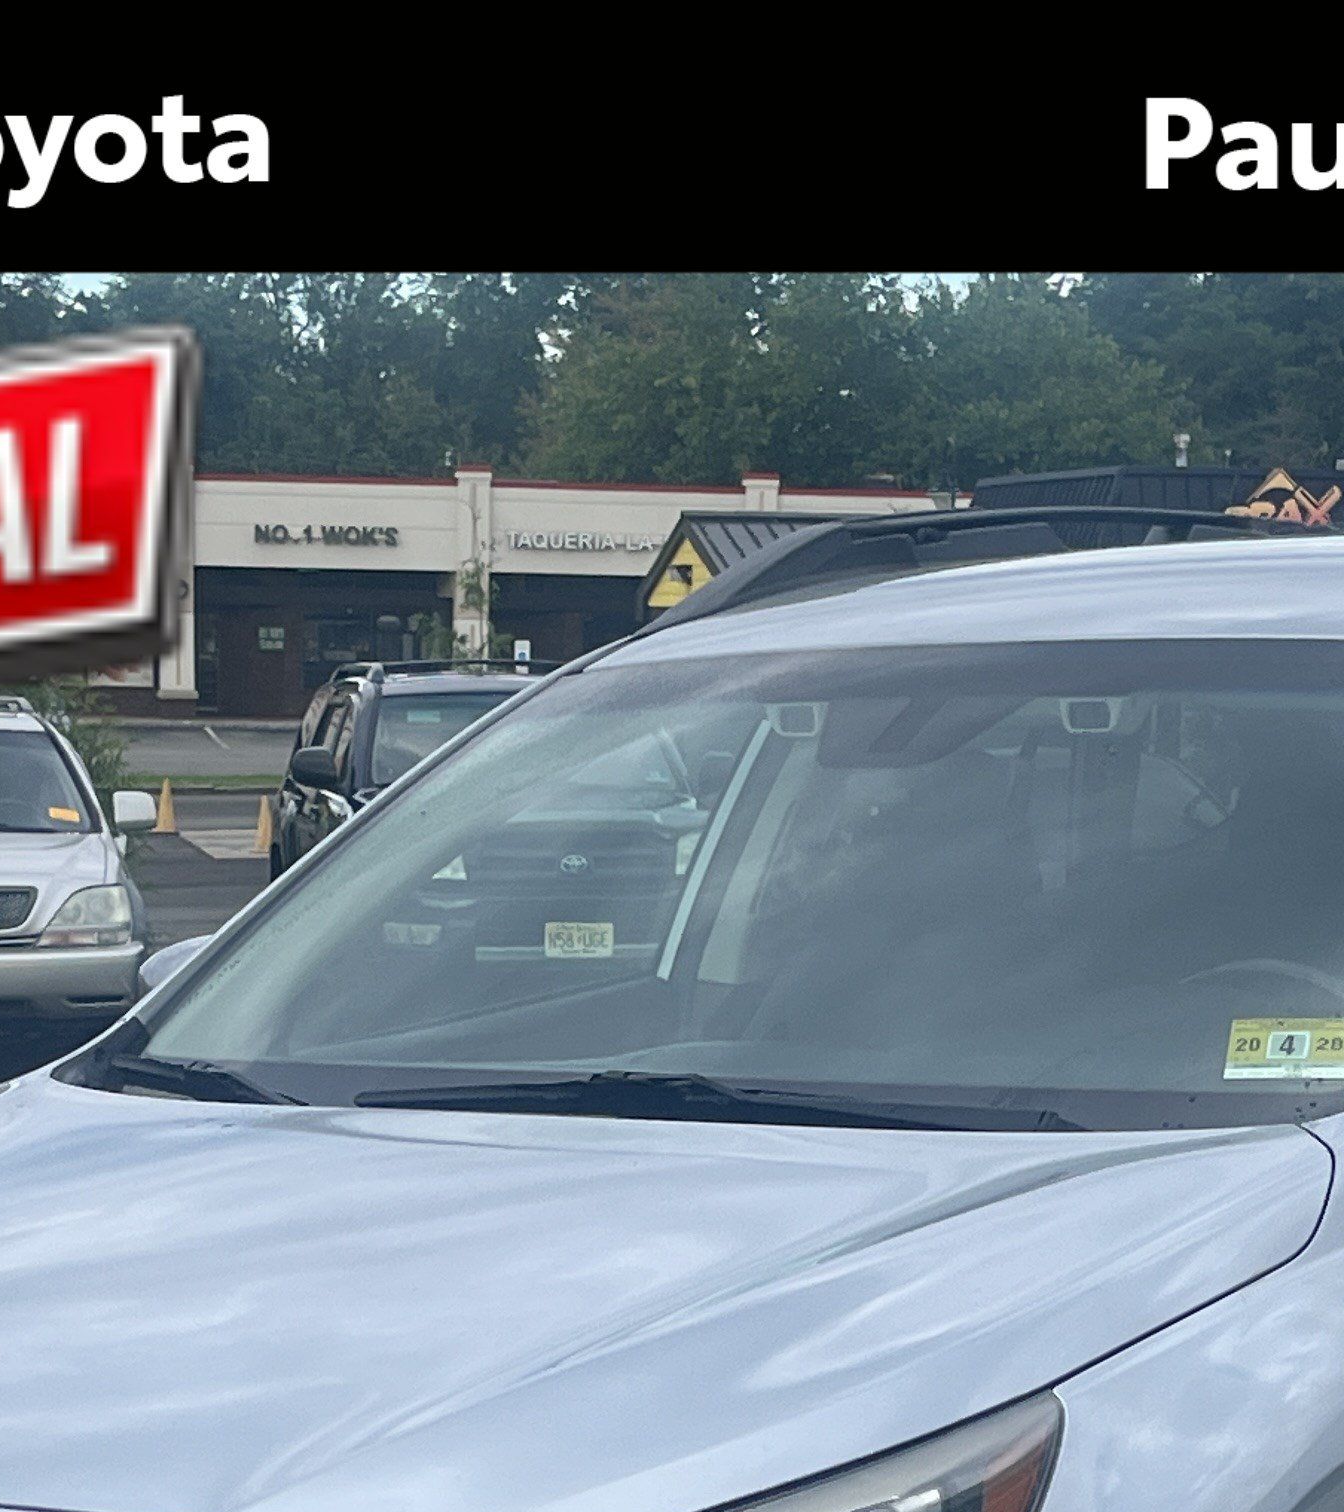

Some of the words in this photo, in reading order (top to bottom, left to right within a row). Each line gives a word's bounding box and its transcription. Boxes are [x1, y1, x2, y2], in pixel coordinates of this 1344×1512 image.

[321, 524, 398, 547] WOK'S
[507, 531, 615, 551] TAQUERIA
[1235, 1037, 1261, 1052] 20
[1279, 1034, 1296, 1056] 4
